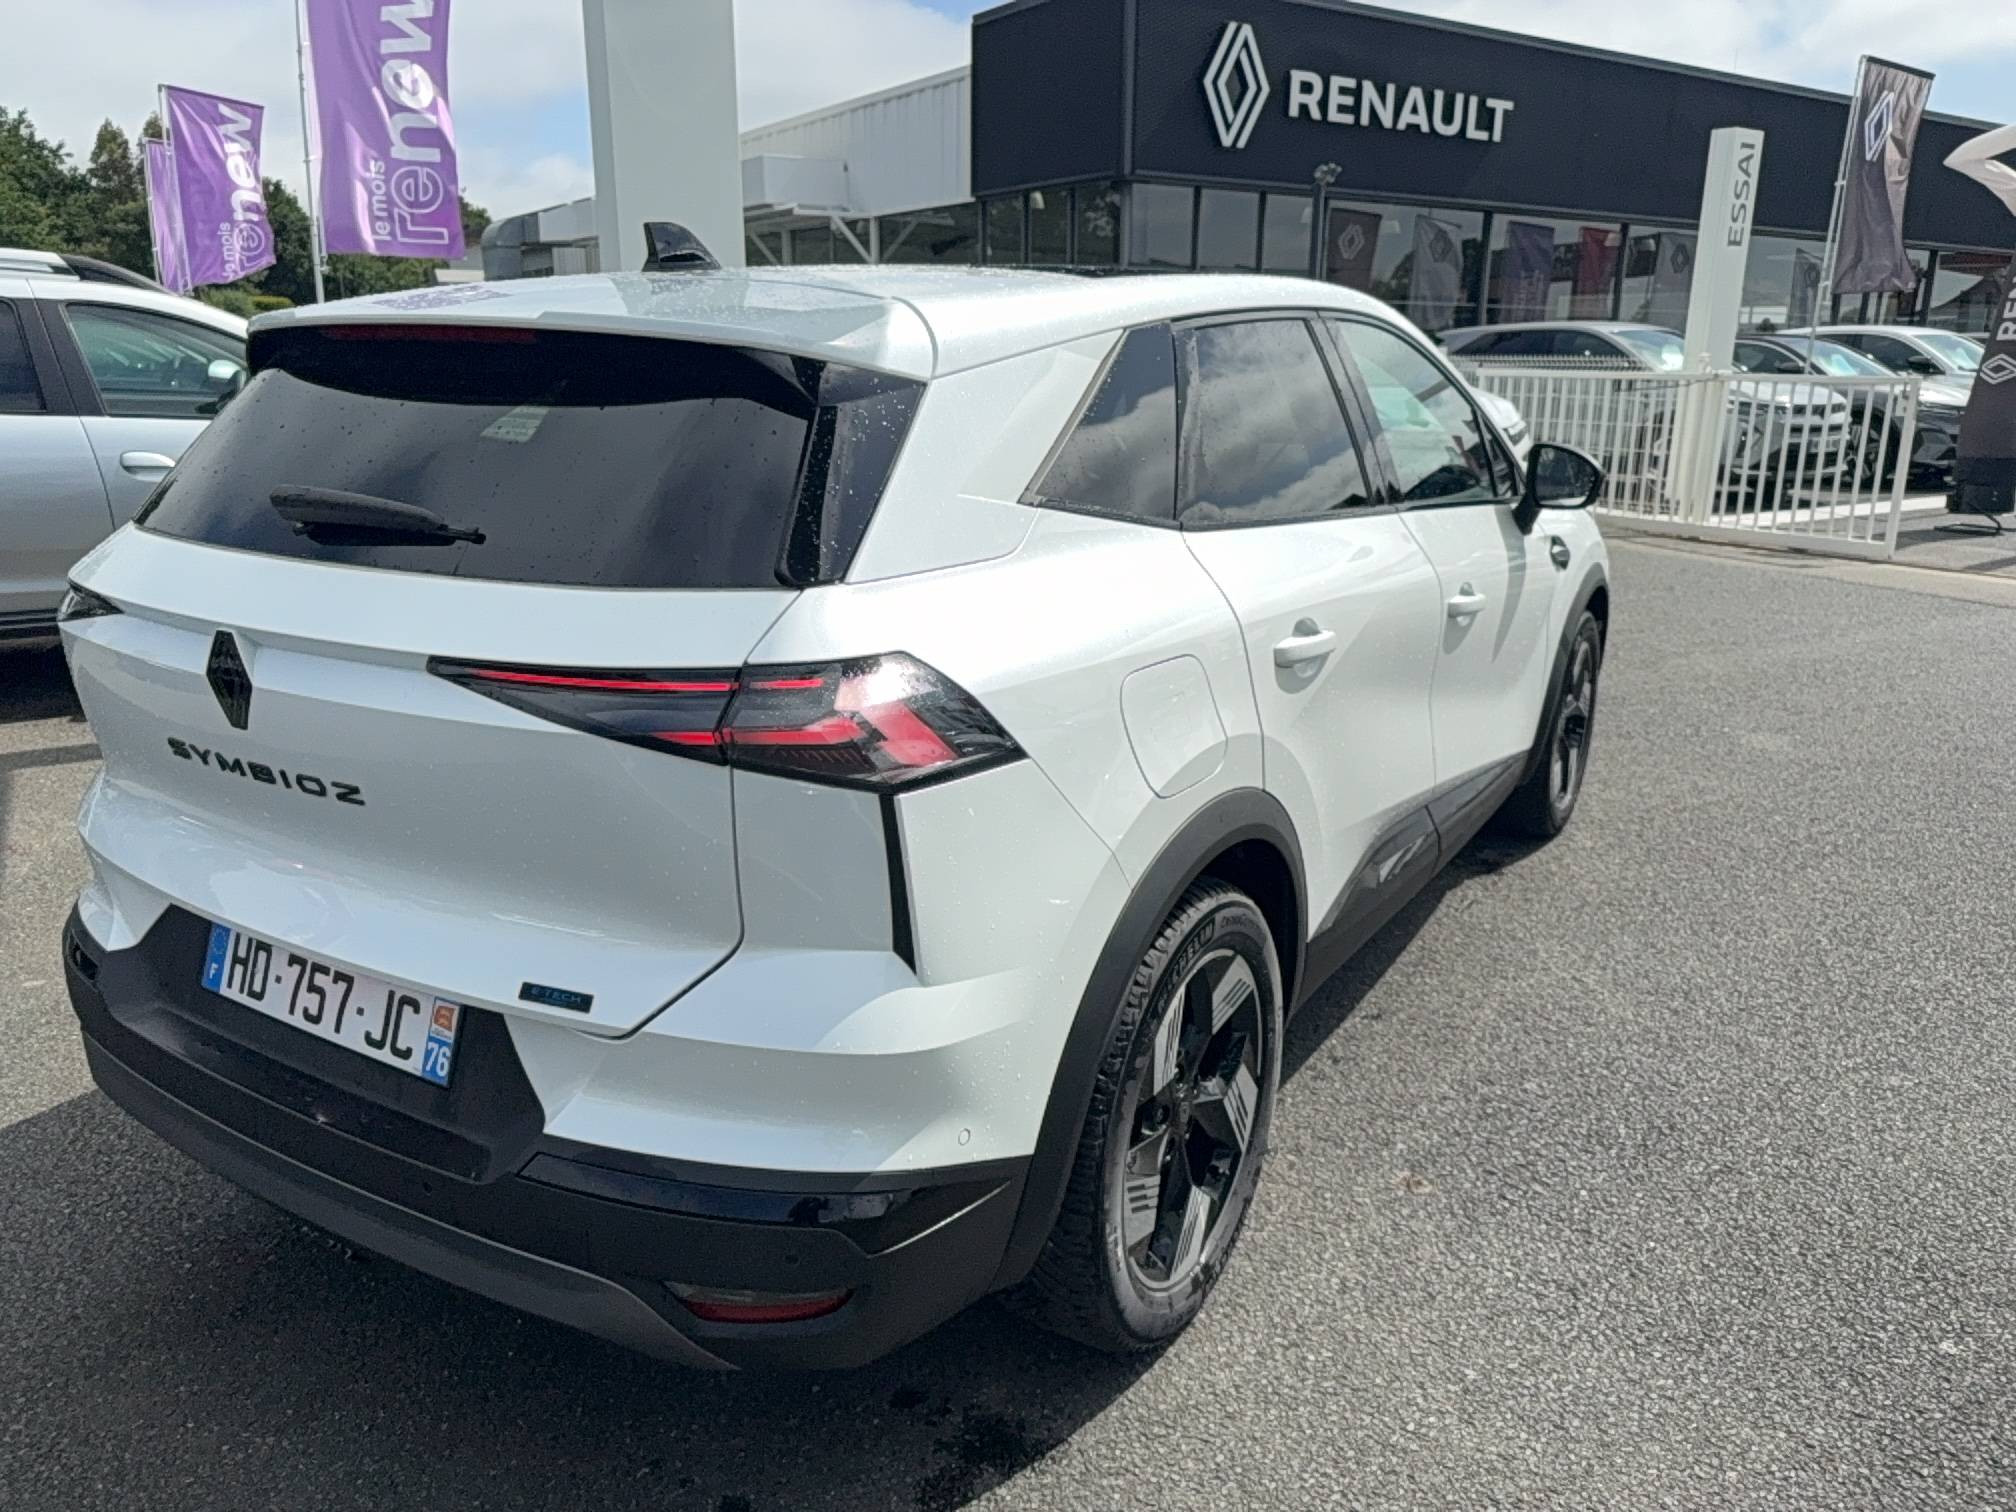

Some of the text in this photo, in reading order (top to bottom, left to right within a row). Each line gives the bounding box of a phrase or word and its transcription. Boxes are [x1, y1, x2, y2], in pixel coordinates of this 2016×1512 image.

[380, 0, 449, 244] renew
[1288, 69, 1515, 143] RENAULT
[370, 159, 391, 241] le mois
[1727, 142, 1755, 247] ESSAI
[217, 221, 232, 262] mois
[167, 737, 366, 805] SYMBIOZ
[208, 963, 219, 979] F
[425, 1042, 450, 1077] 76
